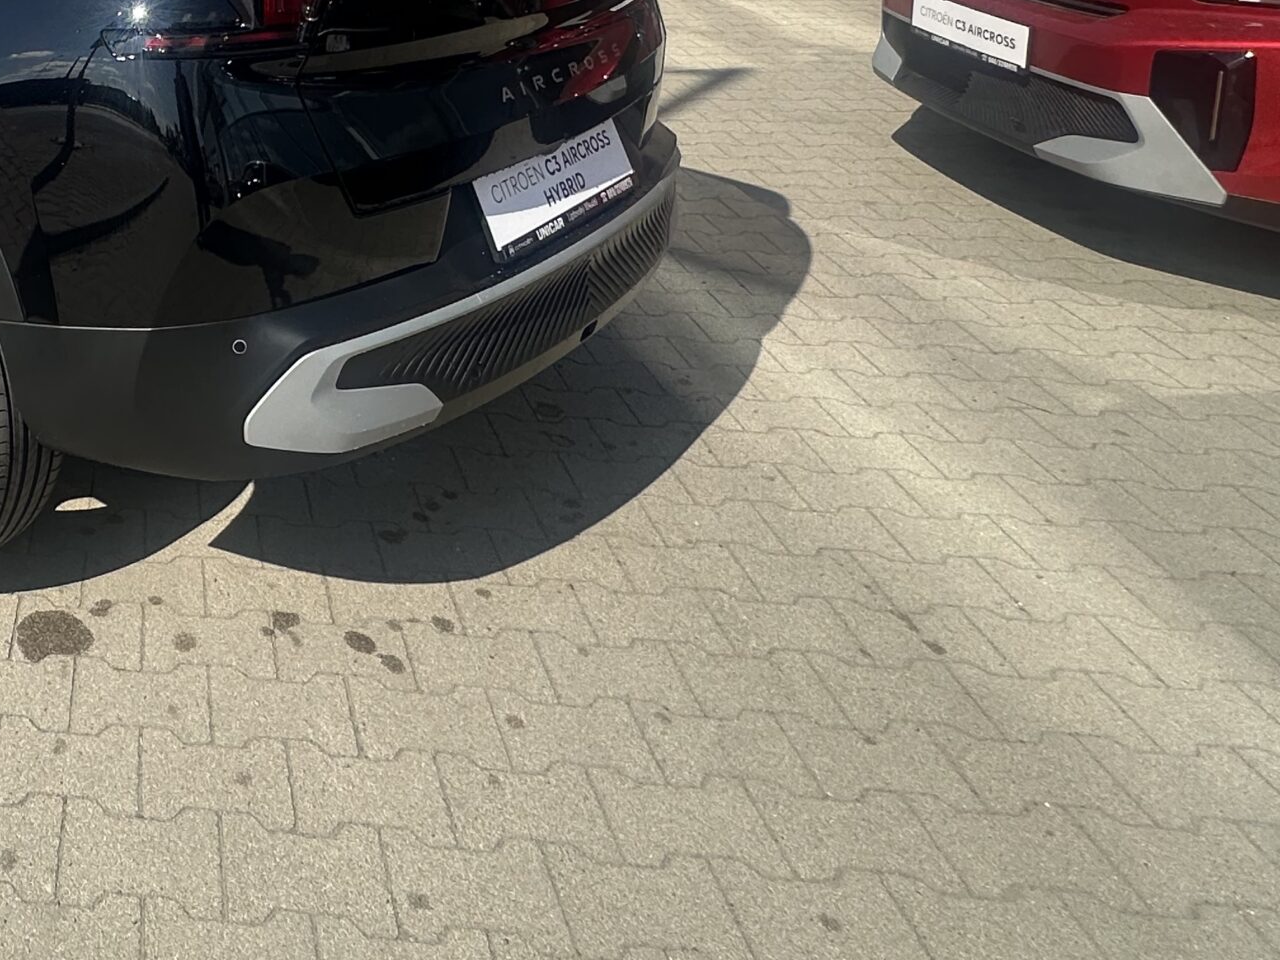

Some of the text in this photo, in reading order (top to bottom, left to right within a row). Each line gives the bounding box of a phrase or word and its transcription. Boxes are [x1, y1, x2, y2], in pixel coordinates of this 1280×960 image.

[920, 4, 954, 27] CITROËN
[954, 19, 966, 33] C3
[967, 23, 1016, 50] AIRCROSS
[502, 43, 622, 103] AIRCROSS
[490, 129, 611, 204] CITROËN C3 AIRCROSS
[543, 171, 586, 207] HYBRID
[535, 217, 565, 241] UNICAR
